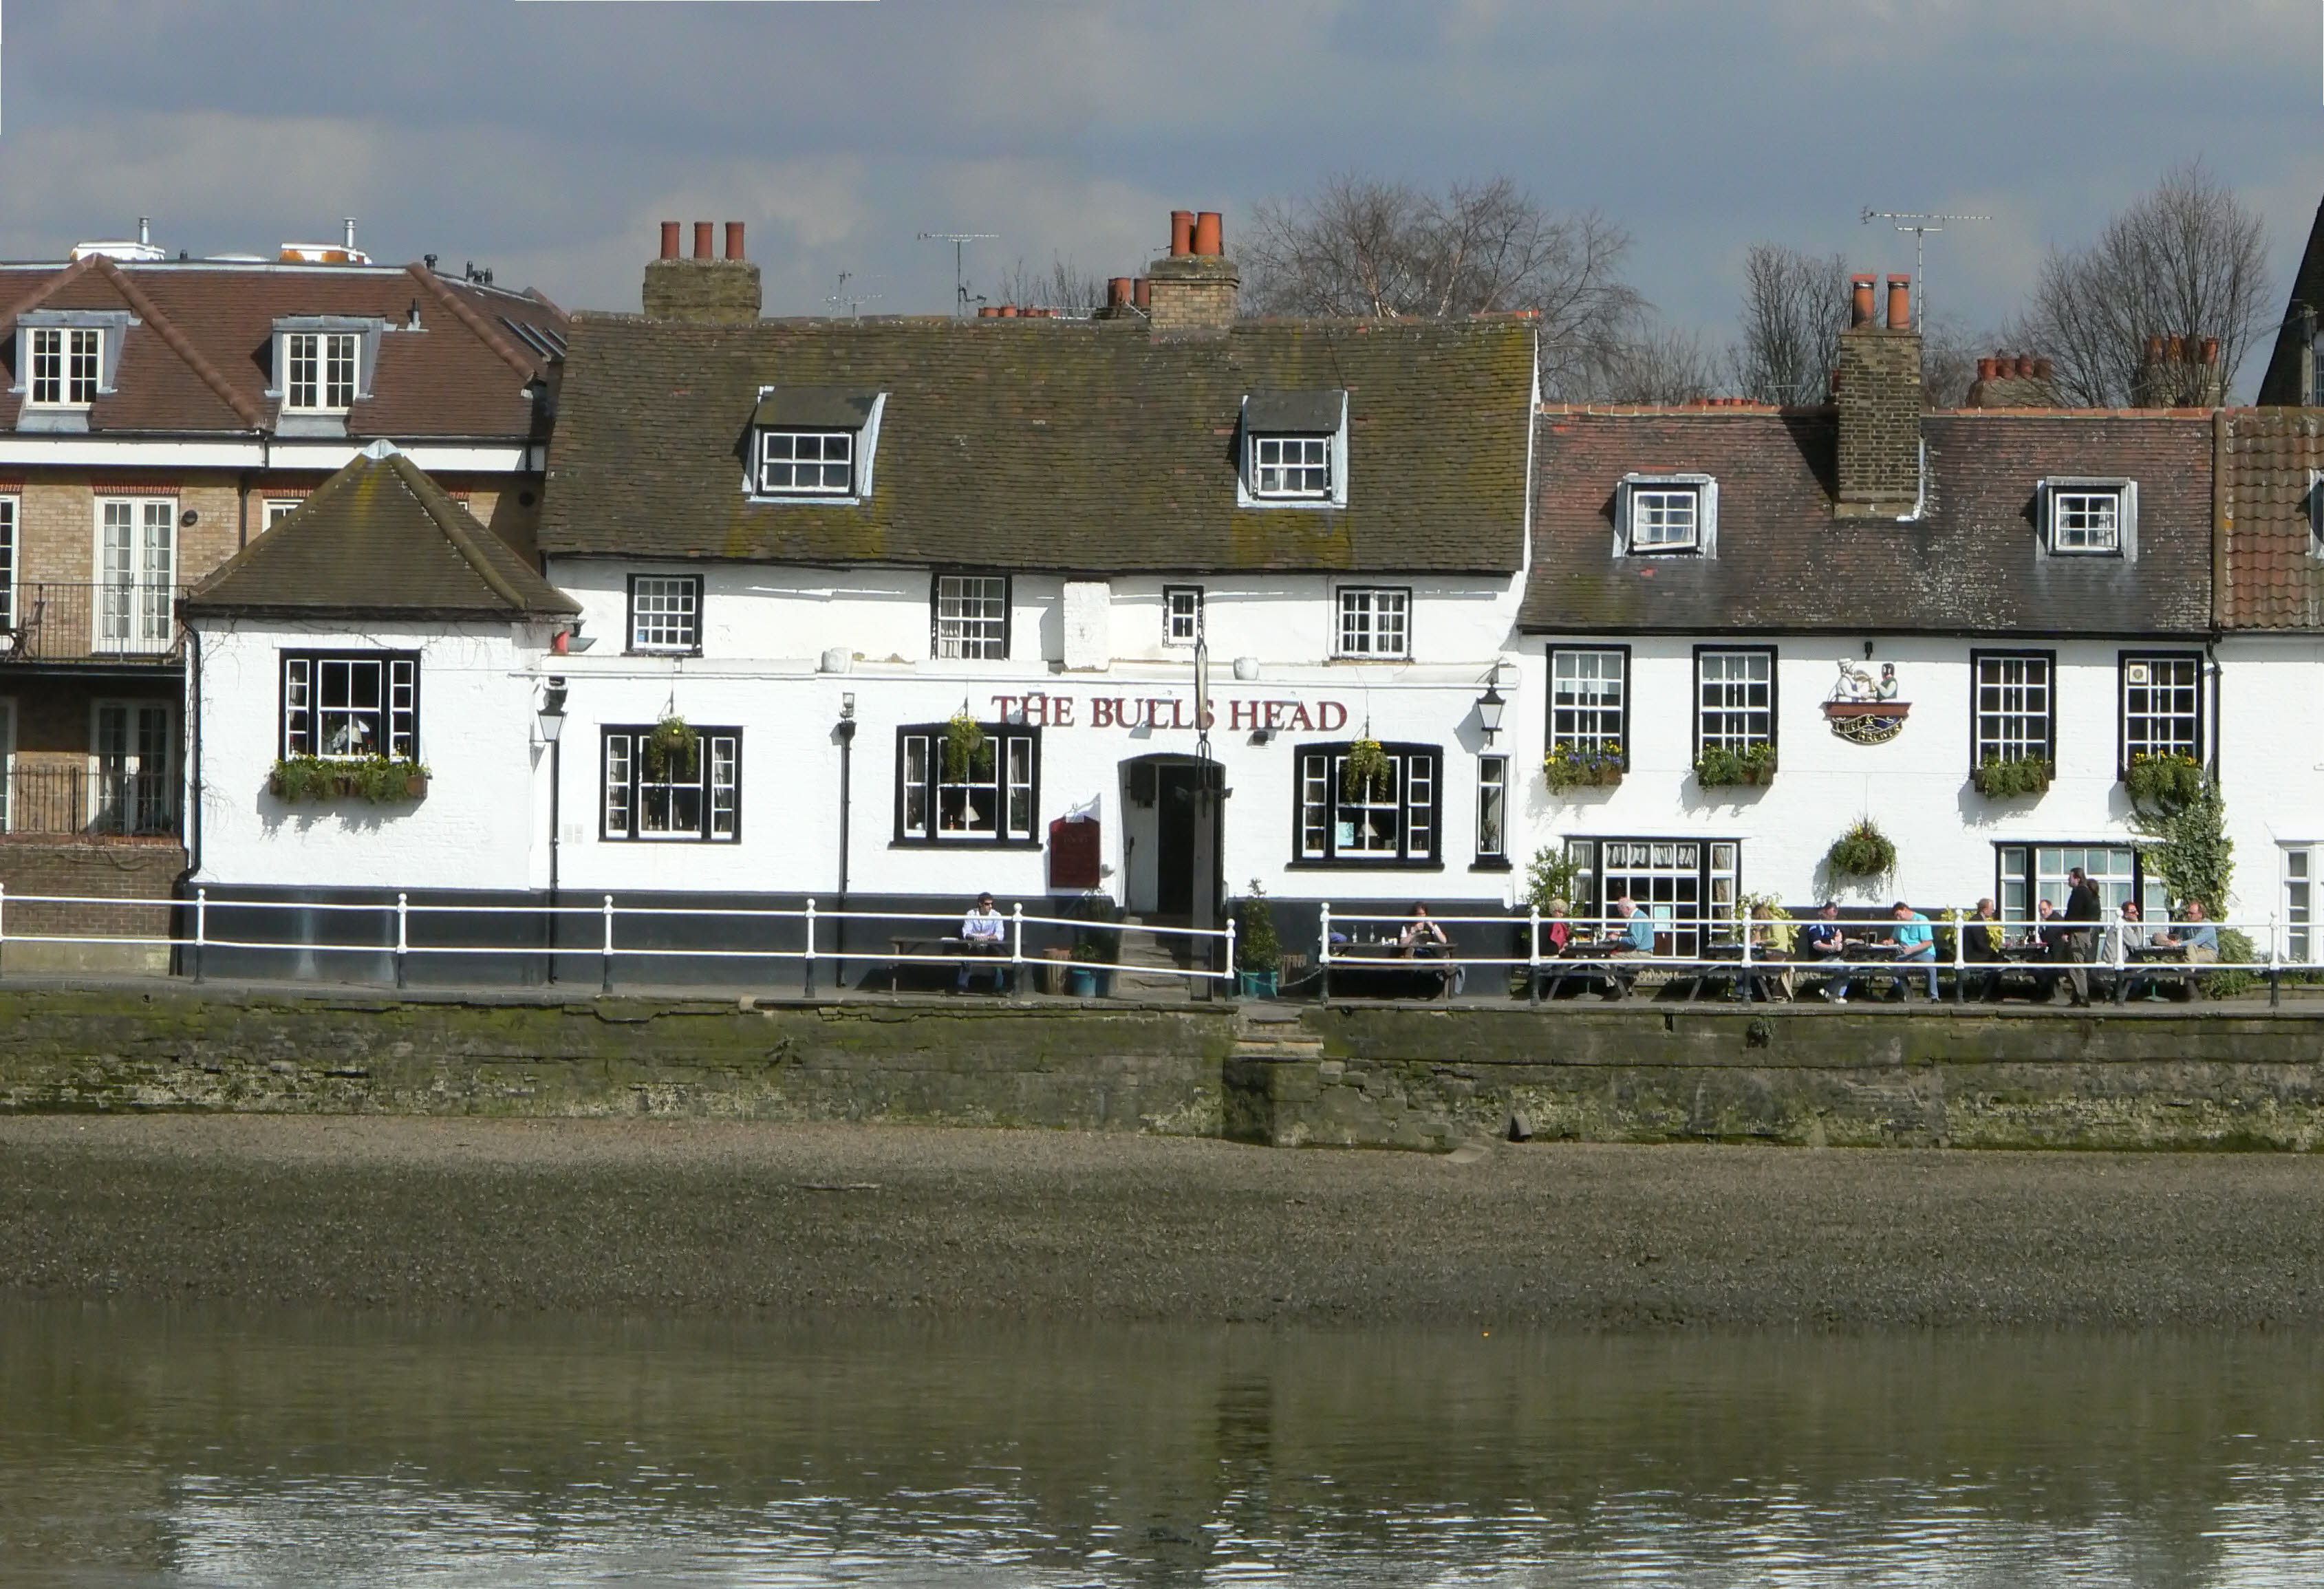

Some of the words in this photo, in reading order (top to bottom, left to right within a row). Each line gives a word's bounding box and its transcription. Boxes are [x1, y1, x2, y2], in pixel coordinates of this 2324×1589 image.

[991, 695, 1075, 727] THE
[1228, 700, 1348, 731] HEAD
[1865, 715, 1875, 724] &
